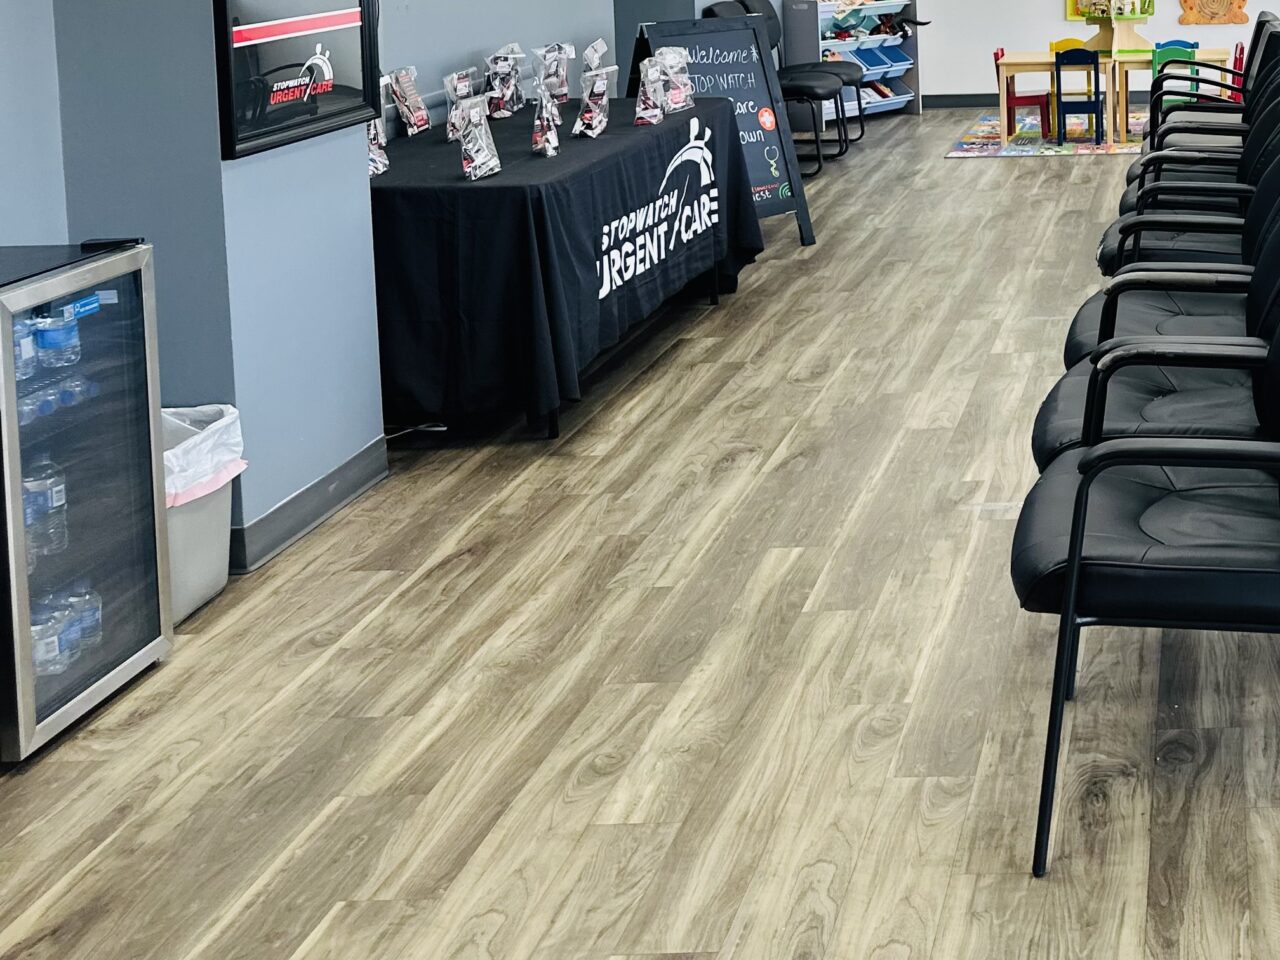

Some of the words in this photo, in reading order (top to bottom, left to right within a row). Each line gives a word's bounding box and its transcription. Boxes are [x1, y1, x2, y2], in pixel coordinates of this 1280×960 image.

[686, 44, 750, 64] Welcome
[269, 84, 305, 105] URGENT
[310, 79, 333, 96] CARE
[272, 76, 310, 91] STOPWATCH
[601, 189, 679, 252] STOPWATCH
[595, 225, 668, 300] URGENT
[681, 189, 719, 244] CARE
